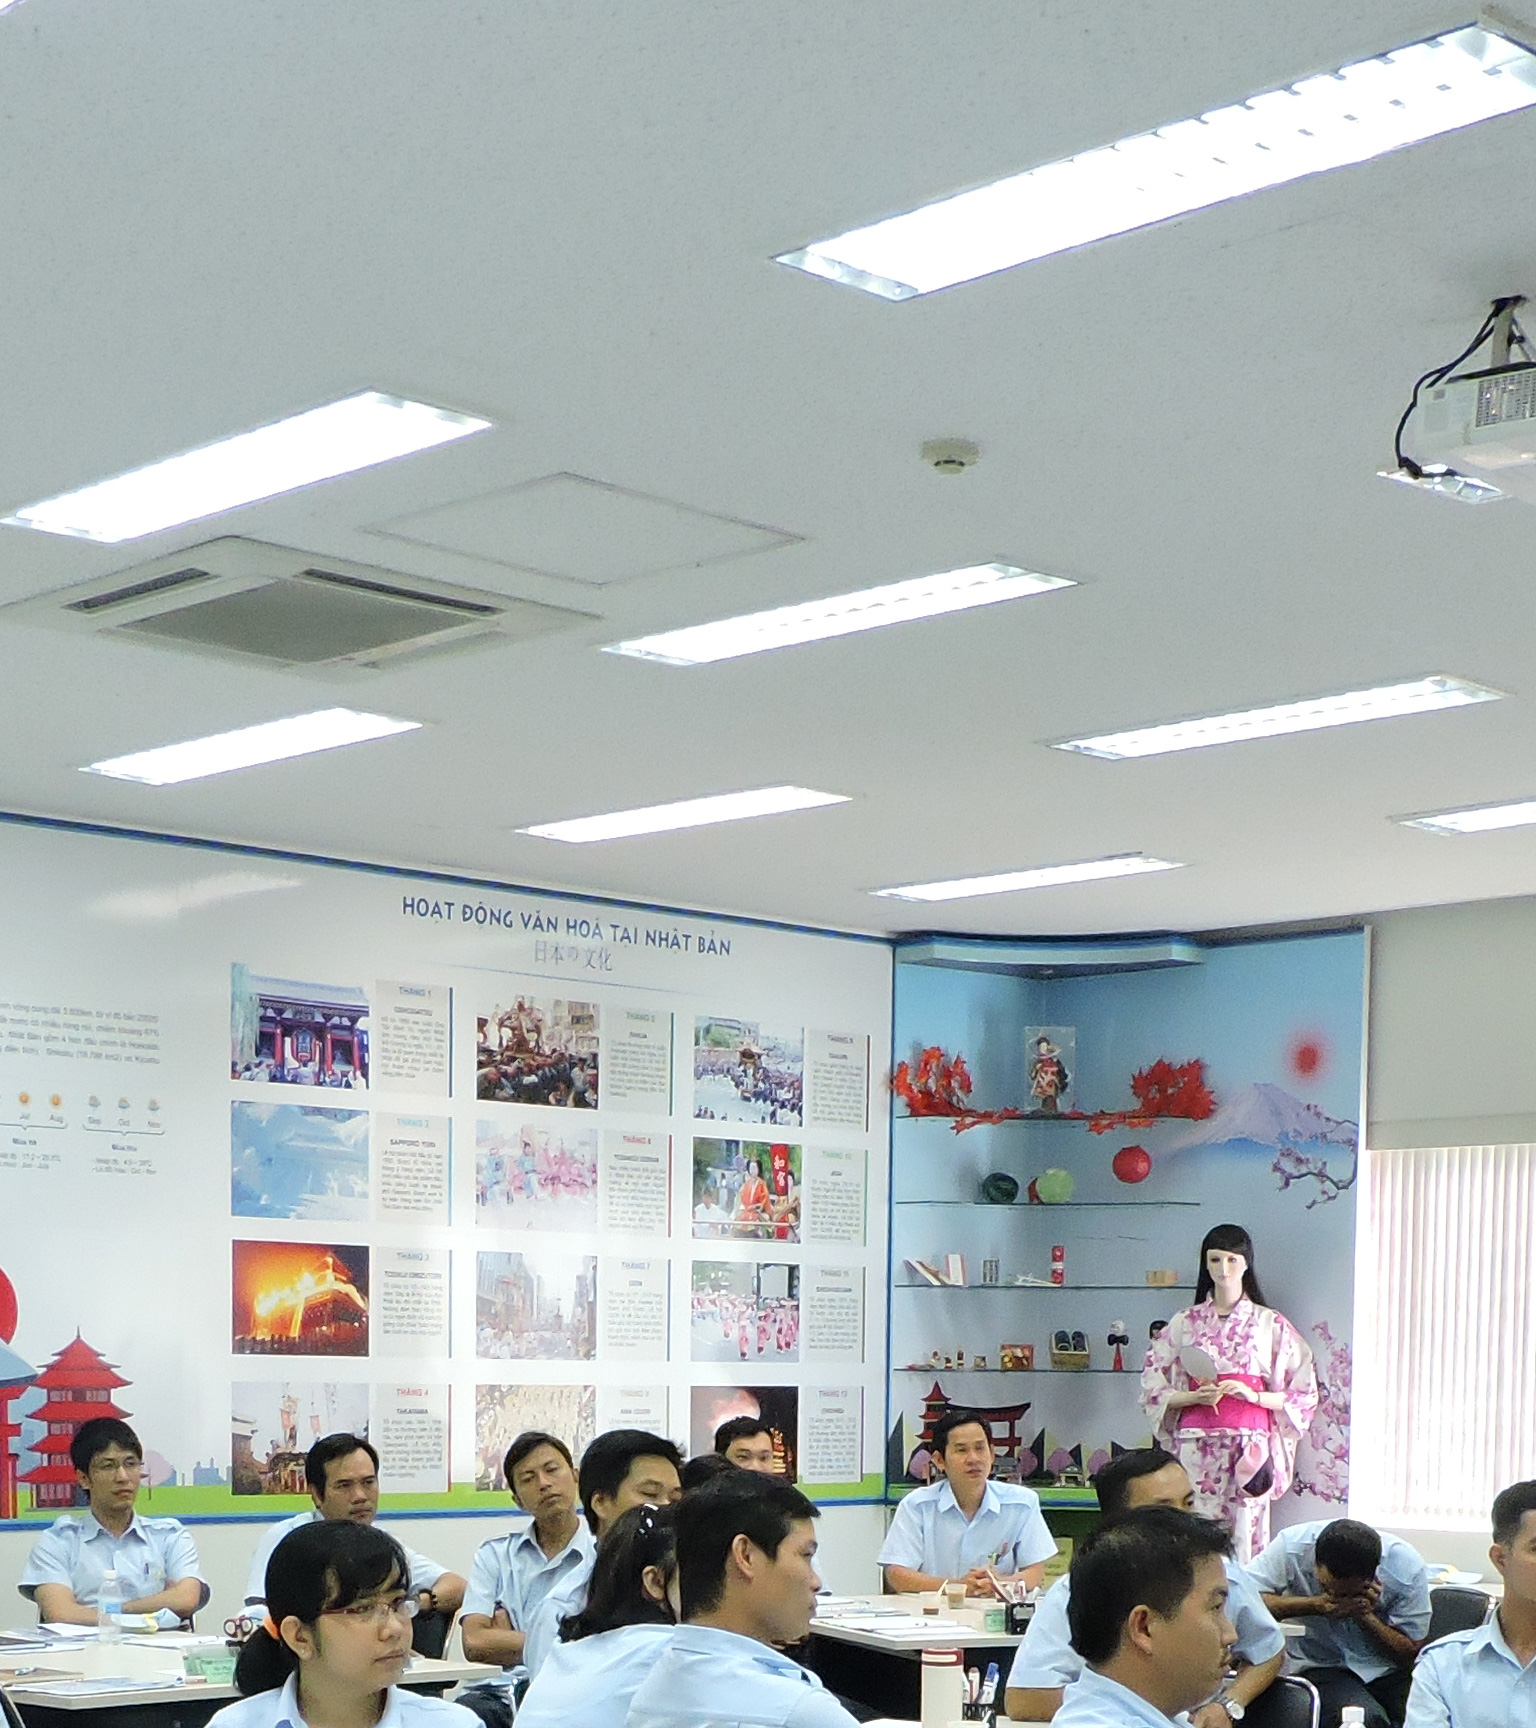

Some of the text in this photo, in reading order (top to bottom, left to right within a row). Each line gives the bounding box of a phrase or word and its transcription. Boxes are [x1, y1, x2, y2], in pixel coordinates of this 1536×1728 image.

[403, 897, 455, 924] HOẠT
[520, 909, 558, 934] VĂN
[645, 928, 692, 953] NHẬT
[698, 930, 731, 956] BẢN
[534, 940, 613, 972] 日本の文化
